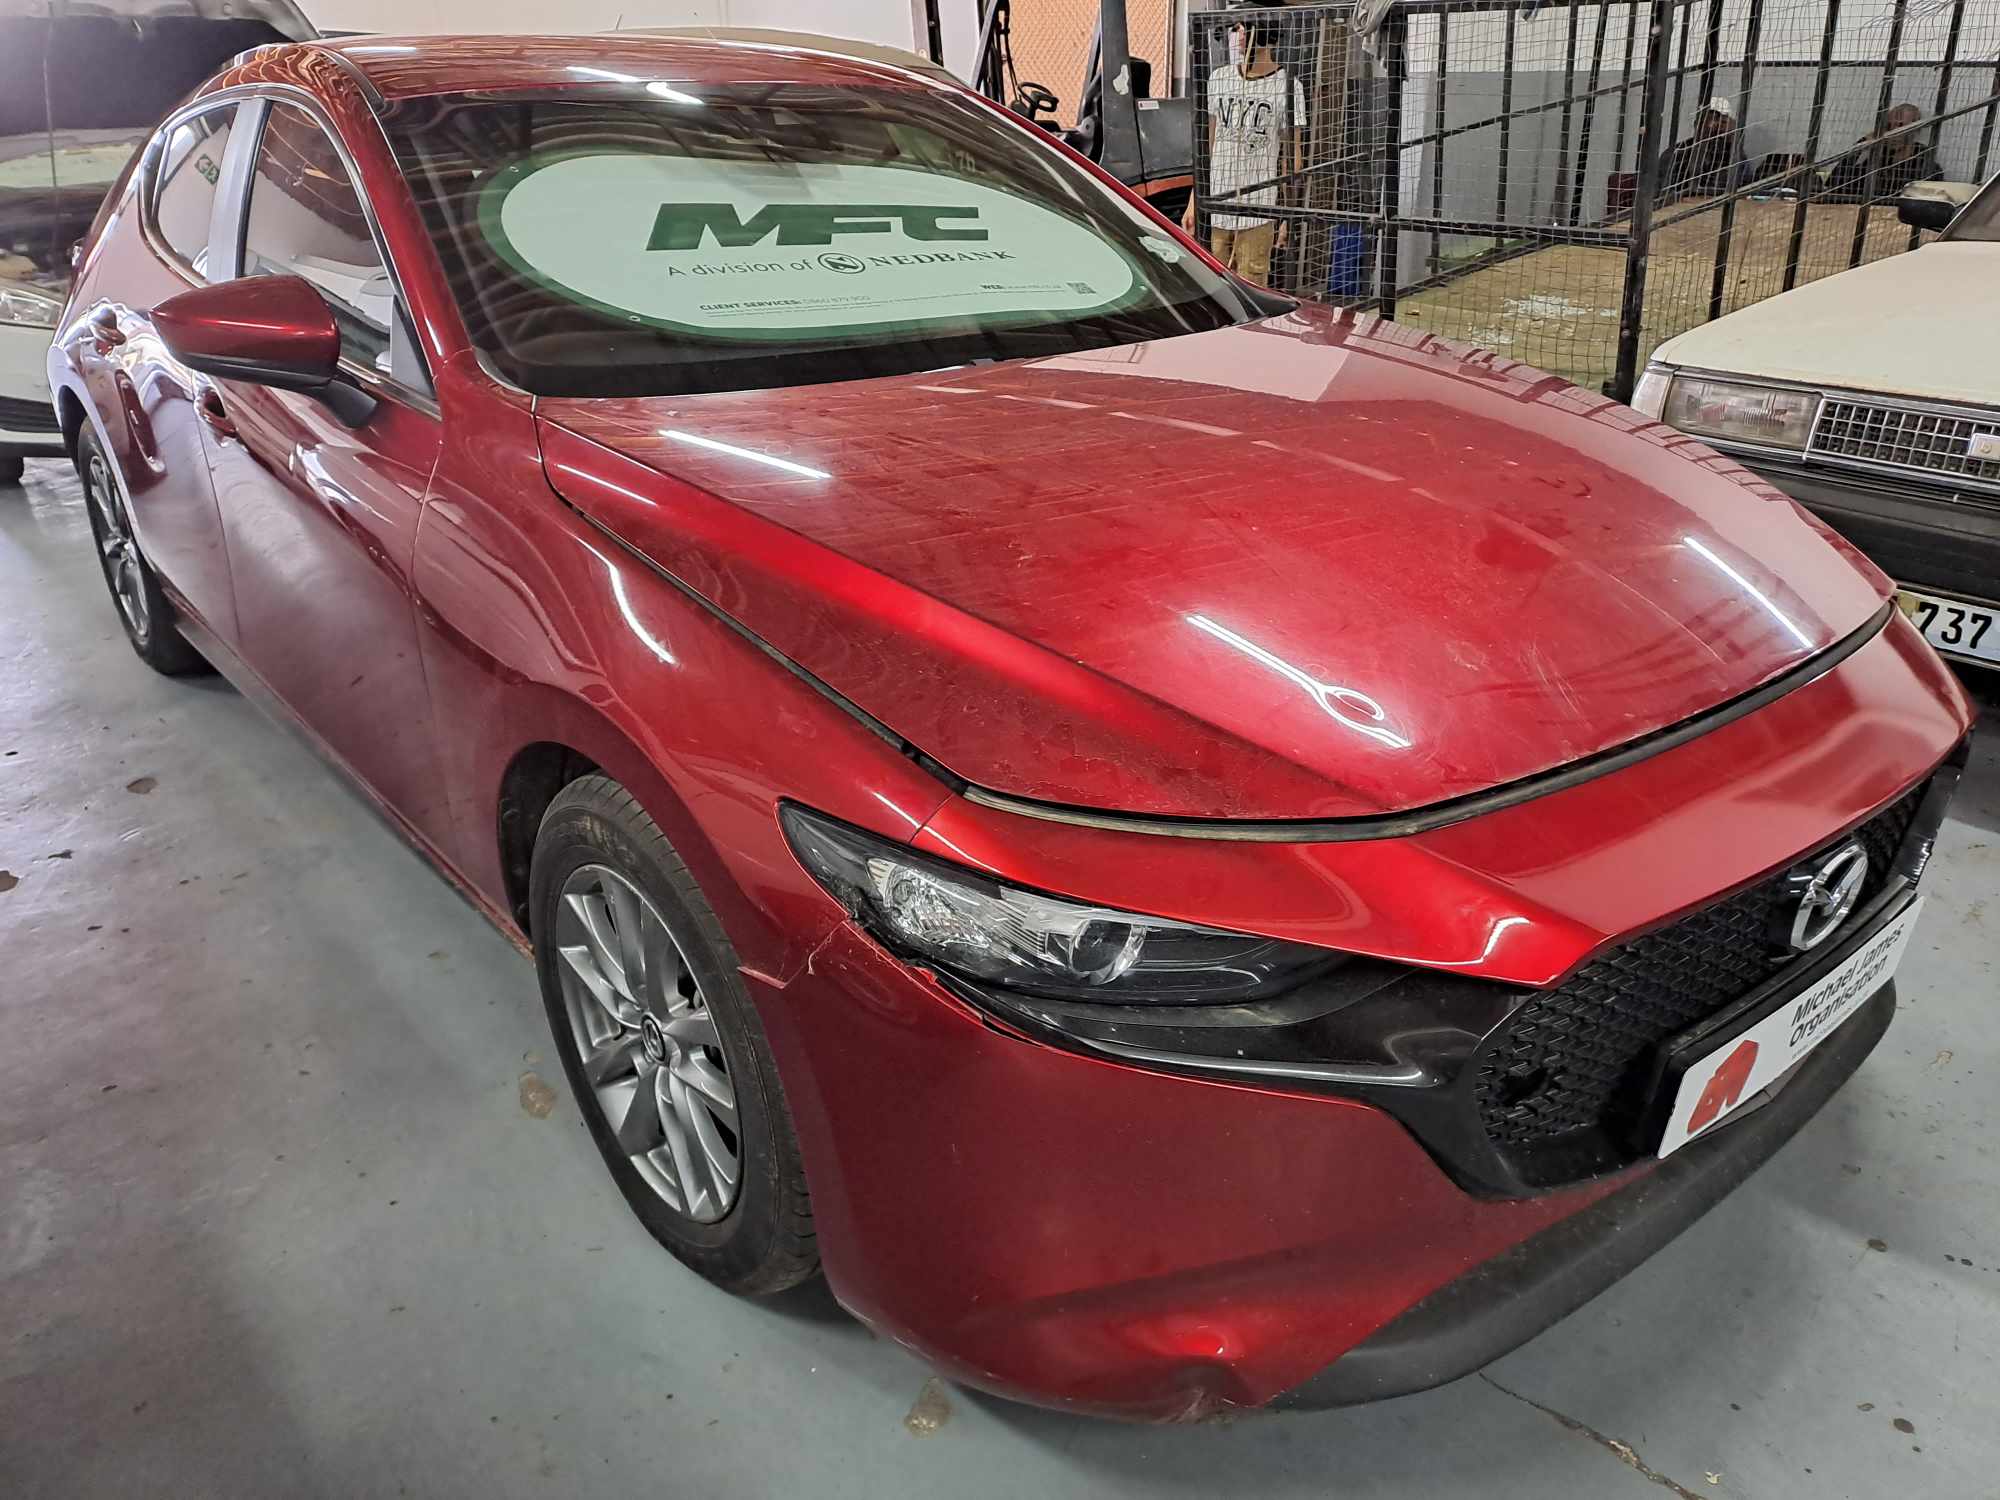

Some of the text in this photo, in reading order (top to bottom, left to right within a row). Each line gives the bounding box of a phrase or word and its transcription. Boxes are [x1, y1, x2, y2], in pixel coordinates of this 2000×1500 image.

[646, 203, 988, 251] MFC
[668, 250, 1016, 277] A division of NEDBANK
[700, 302, 740, 311] CLIENT
[1918, 601, 1993, 649] 737
[1791, 922, 1904, 1026] Michael James
[1789, 954, 1888, 1047] Organisation
